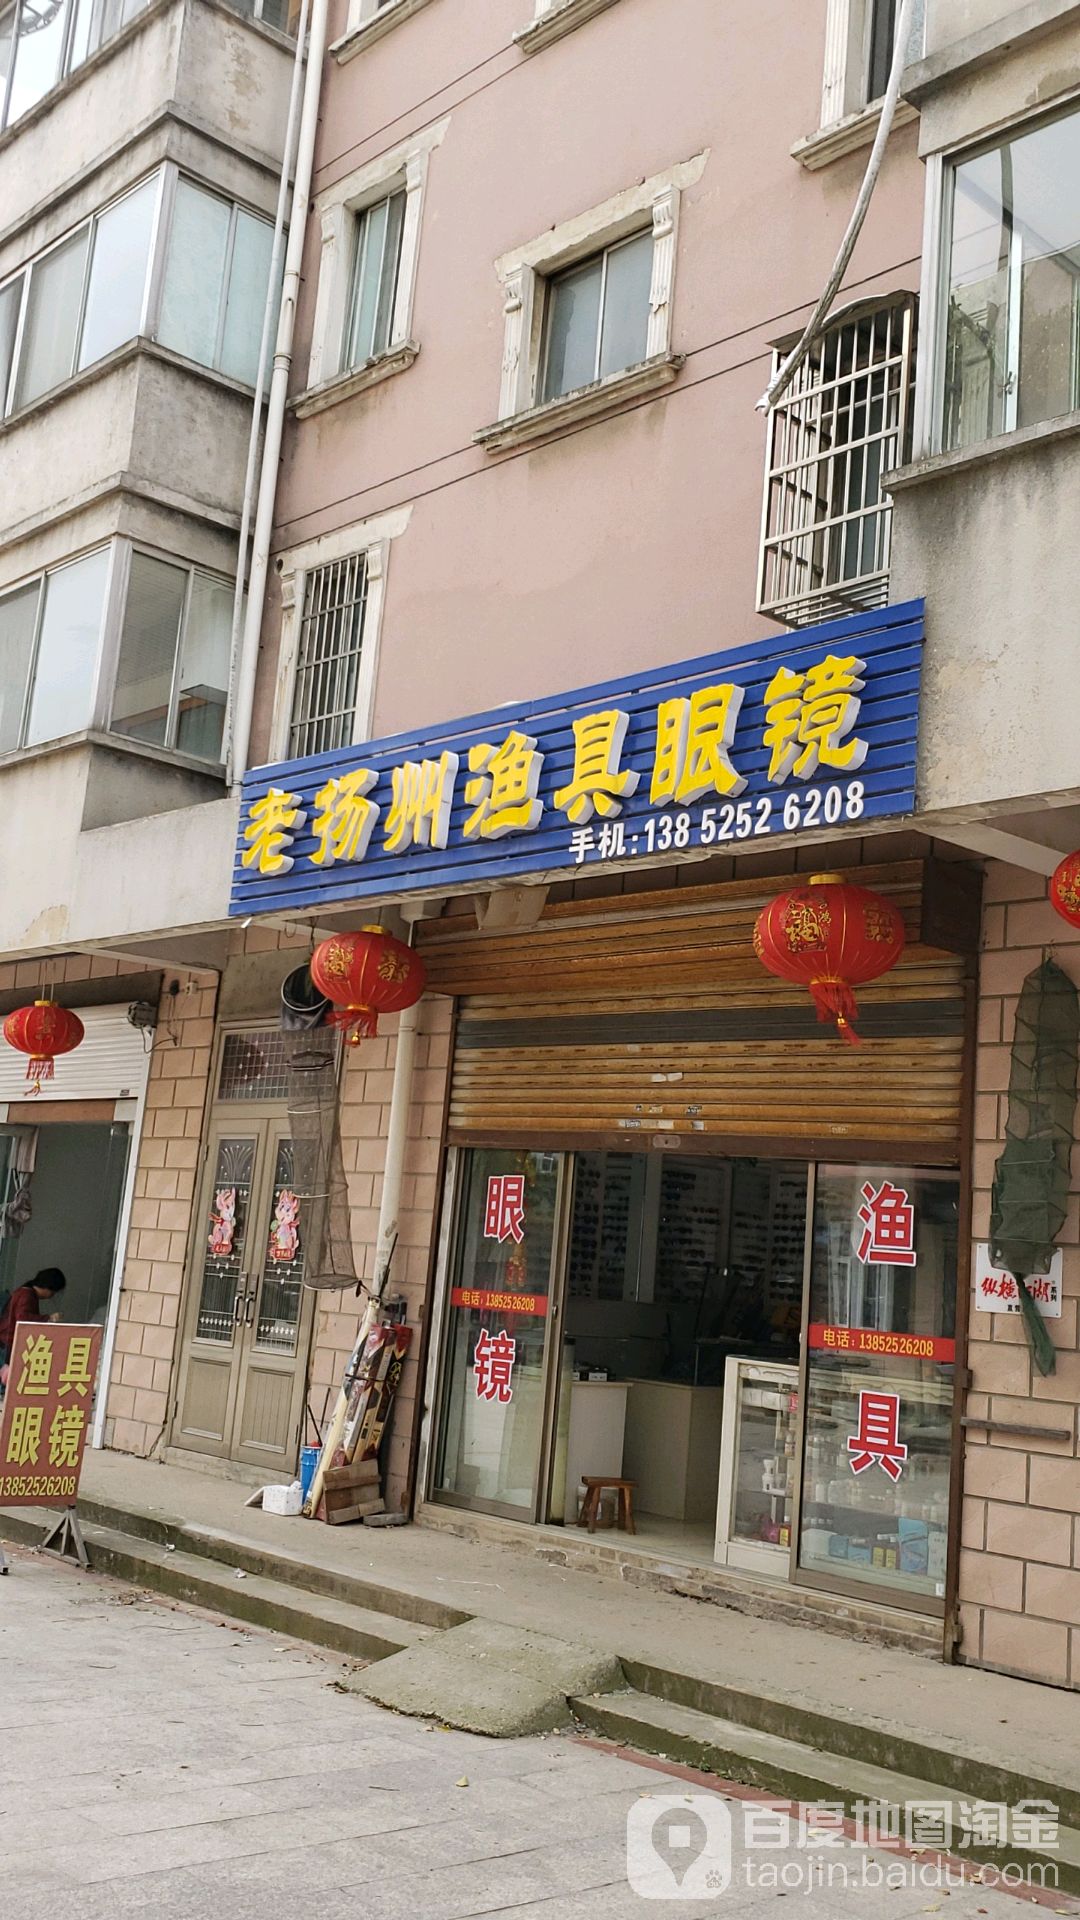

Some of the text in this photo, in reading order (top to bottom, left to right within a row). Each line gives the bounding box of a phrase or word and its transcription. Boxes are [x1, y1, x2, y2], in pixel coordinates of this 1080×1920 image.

[241, 654, 869, 876] 老扬州渔具眼镜
[701, 798, 772, 843] 5252
[783, 781, 865, 830] 6208
[981, 1273, 1051, 1302] 纵横湖
[16, 1334, 92, 1397] 渔具
[6, 1404, 85, 1468] 眼镜
[0, 1476, 76, 1497] 13852526208
